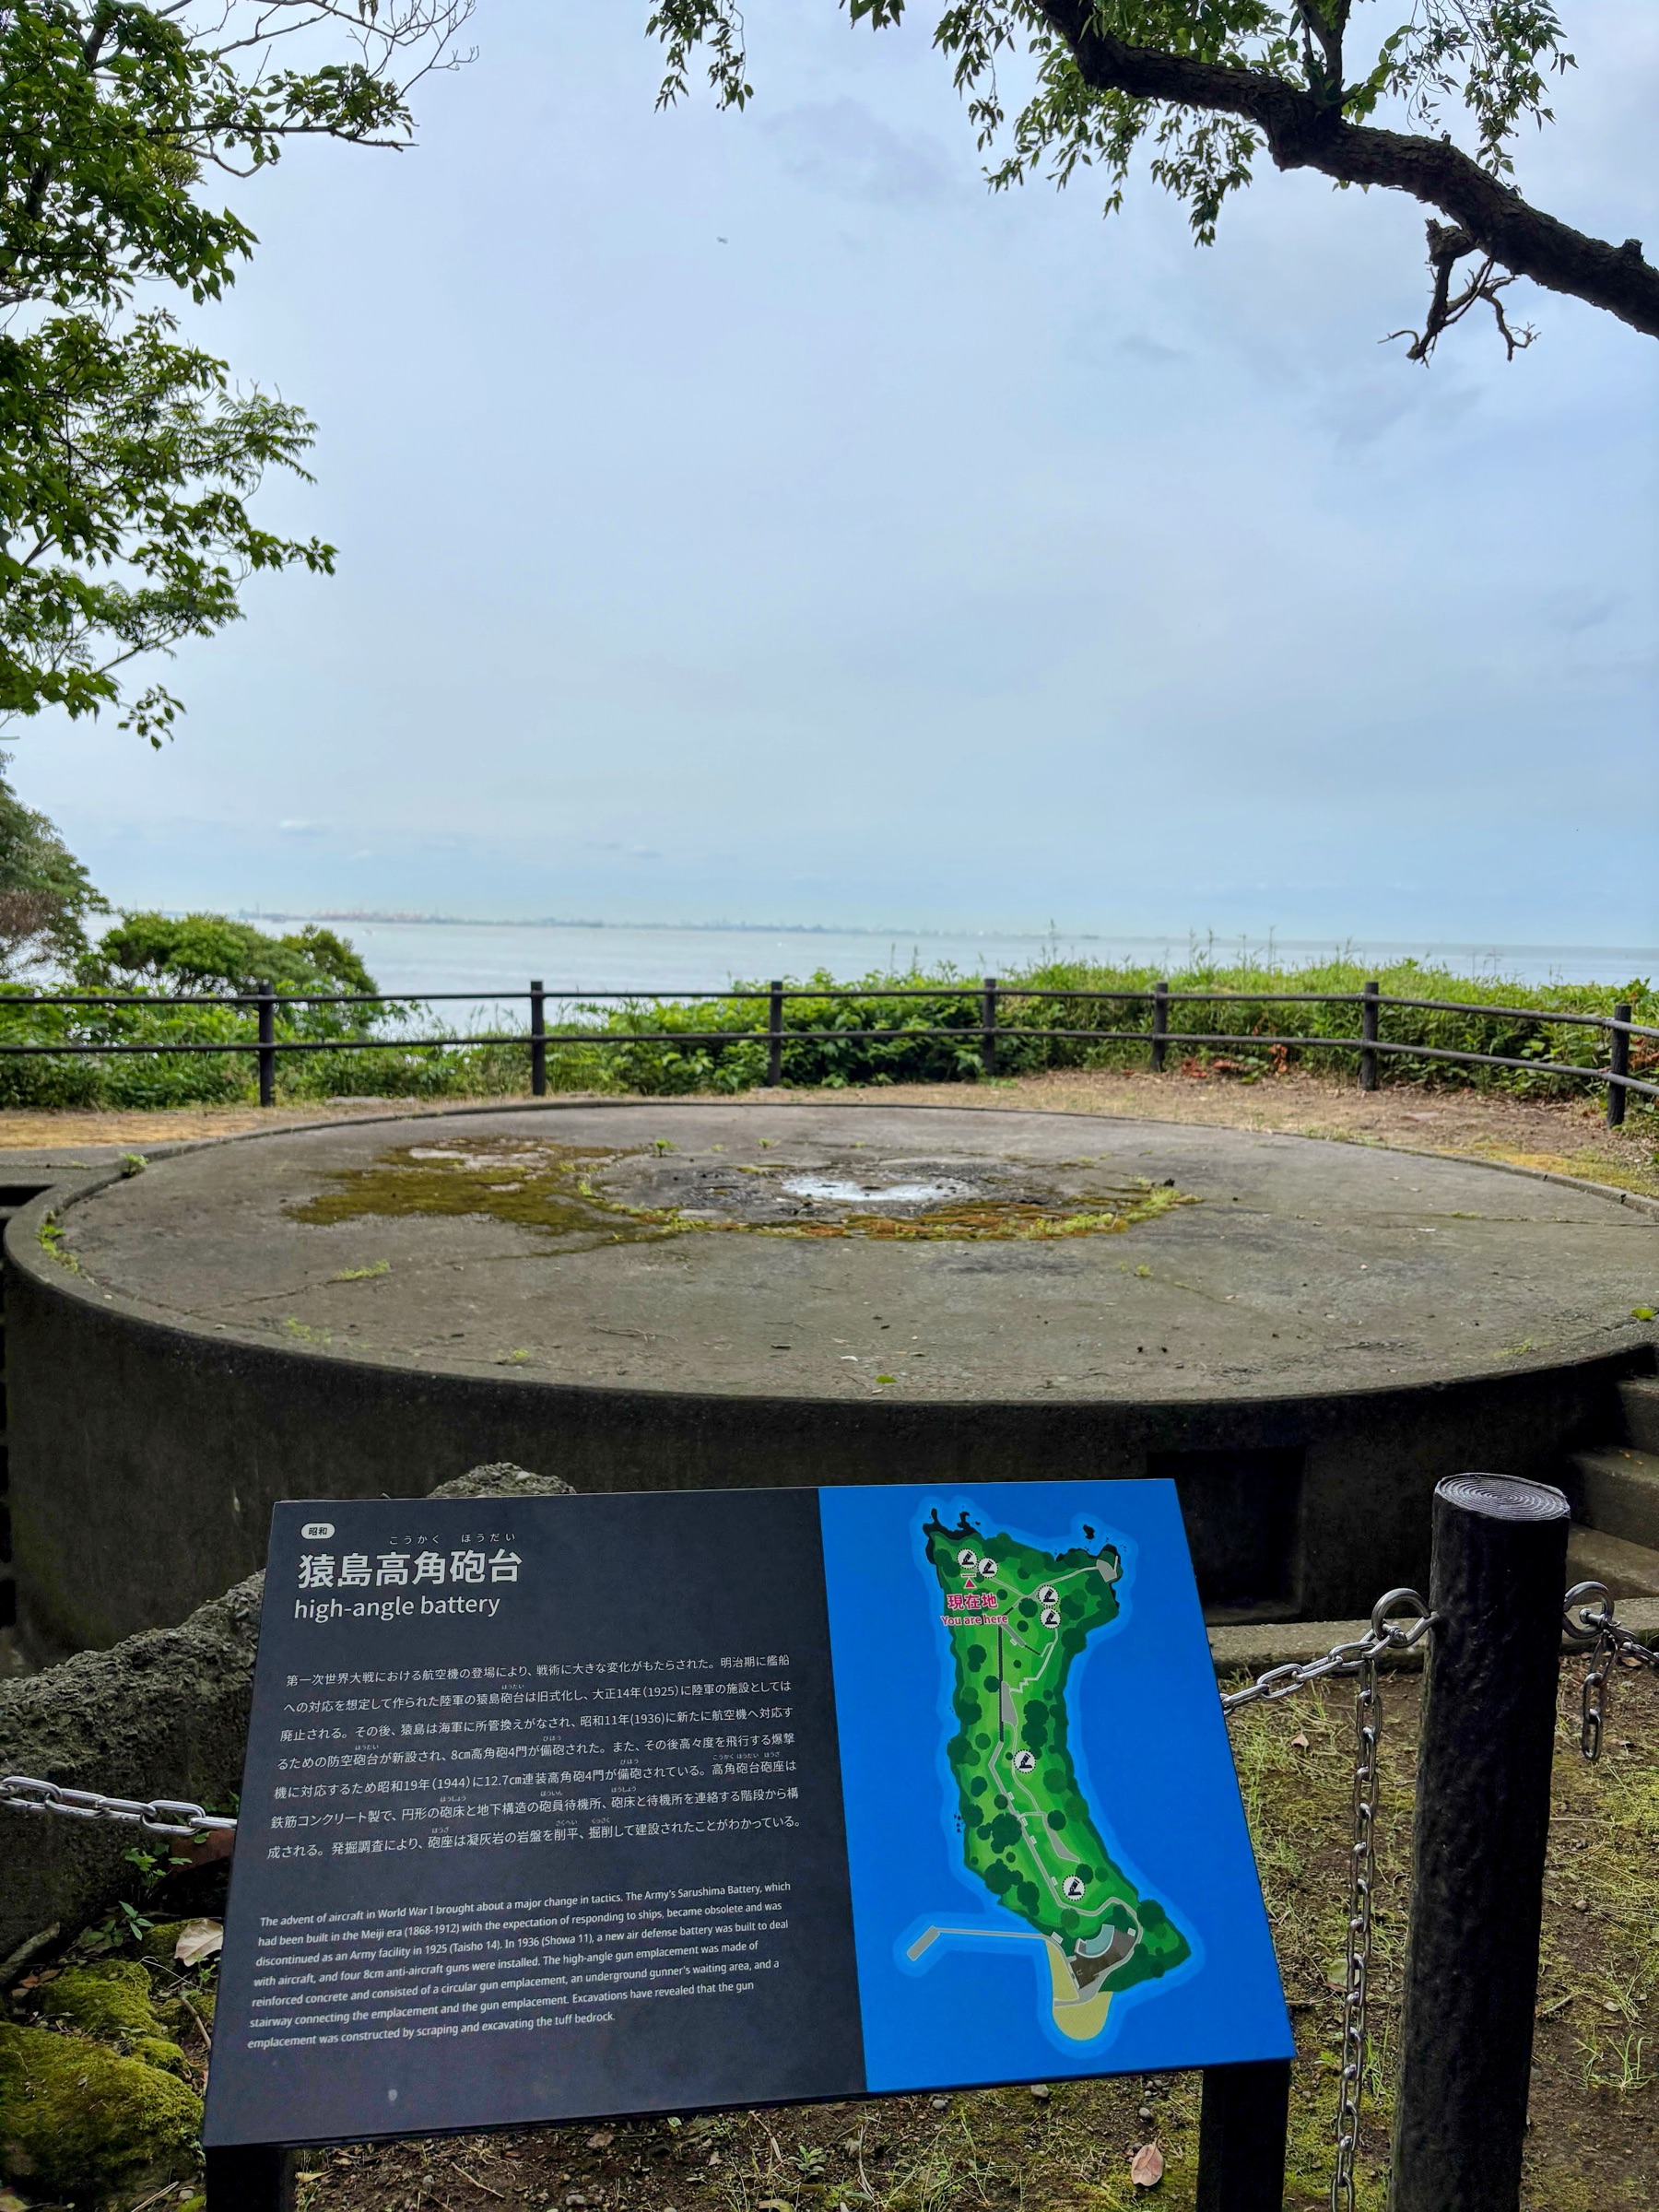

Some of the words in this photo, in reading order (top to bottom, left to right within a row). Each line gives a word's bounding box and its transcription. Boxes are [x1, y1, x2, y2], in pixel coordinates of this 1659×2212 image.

[309, 1526, 328, 1536] 昭和
[389, 1535, 440, 1546] こうかく
[461, 1533, 515, 1544] ほうだい
[298, 1548, 523, 1589] 猿島高角砲台
[294, 1595, 415, 1623] high-angle
[420, 1595, 500, 1617] battery
[941, 1616, 961, 1625] You
[964, 1616, 982, 1625] are
[982, 1614, 1008, 1625] here
[947, 1594, 998, 1610] 現在地
[257, 1935, 277, 1947] had
[278, 1935, 304, 1946] been
[305, 1932, 329, 1944] built
[330, 1932, 341, 1942] in
[341, 1930, 359, 1941] the
[360, 1928, 385, 1942] Meiji
[386, 1929, 403, 1938] era
[404, 1923, 460, 1938] (1868-1912)
[461, 1921, 483, 1933] with
[485, 1920, 501, 1931] the
[502, 1916, 558, 1931] expectation
[559, 1914, 571, 1925] of
[571, 1912, 625, 1926] responding
[626, 1912, 637, 1921] to
[638, 1909, 665, 1922] ships,
[666, 1908, 703, 1918] became
[704, 1903, 744, 1915] obsolete
[745, 1901, 763, 1912] and
[764, 1902, 782, 1912] was
[259, 1916, 279, 1927] The
[279, 1914, 314, 1926] advent
[316, 1912, 328, 1924] of
[327, 1910, 365, 1923] aircraft
[366, 1910, 376, 1920] in
[377, 1907, 407, 1919] World
[408, 1906, 429, 1917] War
[429, 1905, 434, 1915] I
[435, 1902, 475, 1916] brought
[476, 1901, 505, 1912] about
[506, 1901, 512, 1910] a
[514, 1898, 543, 1912] major
[543, 1897, 579, 1909] change
[580, 1895, 589, 1905] in
[591, 1893, 624, 1904] tactics.
[625, 1891, 643, 1901] The
[643, 1889, 677, 1901] Army's
[677, 1886, 726, 1899] Sarushima
[727, 1885, 763, 1896] Battery,
[764, 1881, 791, 1892] which
[253, 1975, 276, 1987] with
[277, 1972, 317, 1985] aircraft,
[318, 1971, 339, 1983] and
[340, 1971, 362, 1982] four
[363, 1969, 384, 1980] 8cm
[385, 1963, 444, 1978] anti-aircraft
[445, 1963, 470, 1976] guns
[471, 1961, 496, 1971] were
[498, 1956, 541, 1970] installed.
[542, 1955, 561, 1966] The
[562, 1950, 614, 1967] high-angle
[615, 1951, 634, 1963] gun
[635, 1946, 700, 1960] emplacement
[700, 1945, 720, 1954] was
[721, 1941, 747, 1953] made
[748, 1939, 759, 1951] of
[255, 1952, 321, 1967] discontinued
[321, 1953, 334, 1962] as
[335, 1952, 348, 1961] an
[349, 1950, 377, 1961] Army
[378, 1947, 412, 1959] facility
[412, 1945, 422, 1956] in
[425, 1943, 448, 1955] 1925
[449, 1941, 484, 1955] (Taisho
[486, 1939, 503, 1951] 14).
[504, 1938, 515, 1949] In
[517, 1936, 540, 1947] 1936
[541, 1935, 576, 1947] (Showa
[578, 1933, 594, 1945] 11),
[596, 1934, 603, 1942] a
[605, 1933, 625, 1942] new
[626, 1929, 640, 1940] air
[641, 1927, 678, 1939] defense
[679, 1926, 713, 1937] battery
[714, 1924, 734, 1934] was
[735, 1921, 757, 1933] built
[757, 1922, 768, 1931] to
[769, 1919, 789, 1930] deal
[251, 1994, 304, 2007] reinforced
[305, 1992, 348, 2004] concrete
[350, 1989, 371, 2001] and
[371, 1984, 418, 1999] consisted
[420, 1983, 431, 1995] of
[432, 1985, 440, 1994] a
[441, 1981, 478, 1994] circular
[479, 1981, 499, 1994] gun
[500, 1975, 569, 1991] emplacement,
[571, 1974, 583, 1984] an
[585, 1968, 648, 1983] underground
[649, 1965, 691, 1981] gunner's
[692, 1962, 727, 1975] waiting
[728, 1962, 752, 1971] area,
[753, 1959, 771, 1970] and
[773, 1960, 780, 1969] a
[249, 2017, 293, 2029] stairway
[294, 2012, 350, 2025] connecting
[352, 2009, 370, 2021] the
[371, 2006, 440, 2021] emplacement
[440, 2002, 460, 2014] and
[462, 2002, 478, 2013] the
[480, 2001, 500, 2014] gun
[501, 1995, 570, 2011] emplacement.
[571, 1991, 629, 2004] Excavations
[629, 1988, 653, 1999] have
[654, 1983, 695, 1997] revealed
[696, 1983, 716, 1994] that
[718, 1982, 735, 1993] the
[735, 1982, 755, 1994] gun
[246, 2035, 317, 2051] emplacement
[318, 2034, 339, 2044] was
[340, 2027, 401, 2042] constructed
[402, 2027, 415, 2040] by
[416, 2024, 459, 2038] scraping
[460, 2021, 480, 2033] and
[481, 2018, 535, 2031] excavating
[535, 2016, 553, 2028] the
[554, 2013, 572, 2026] tuff
[574, 2011, 616, 2024] bedrock.
